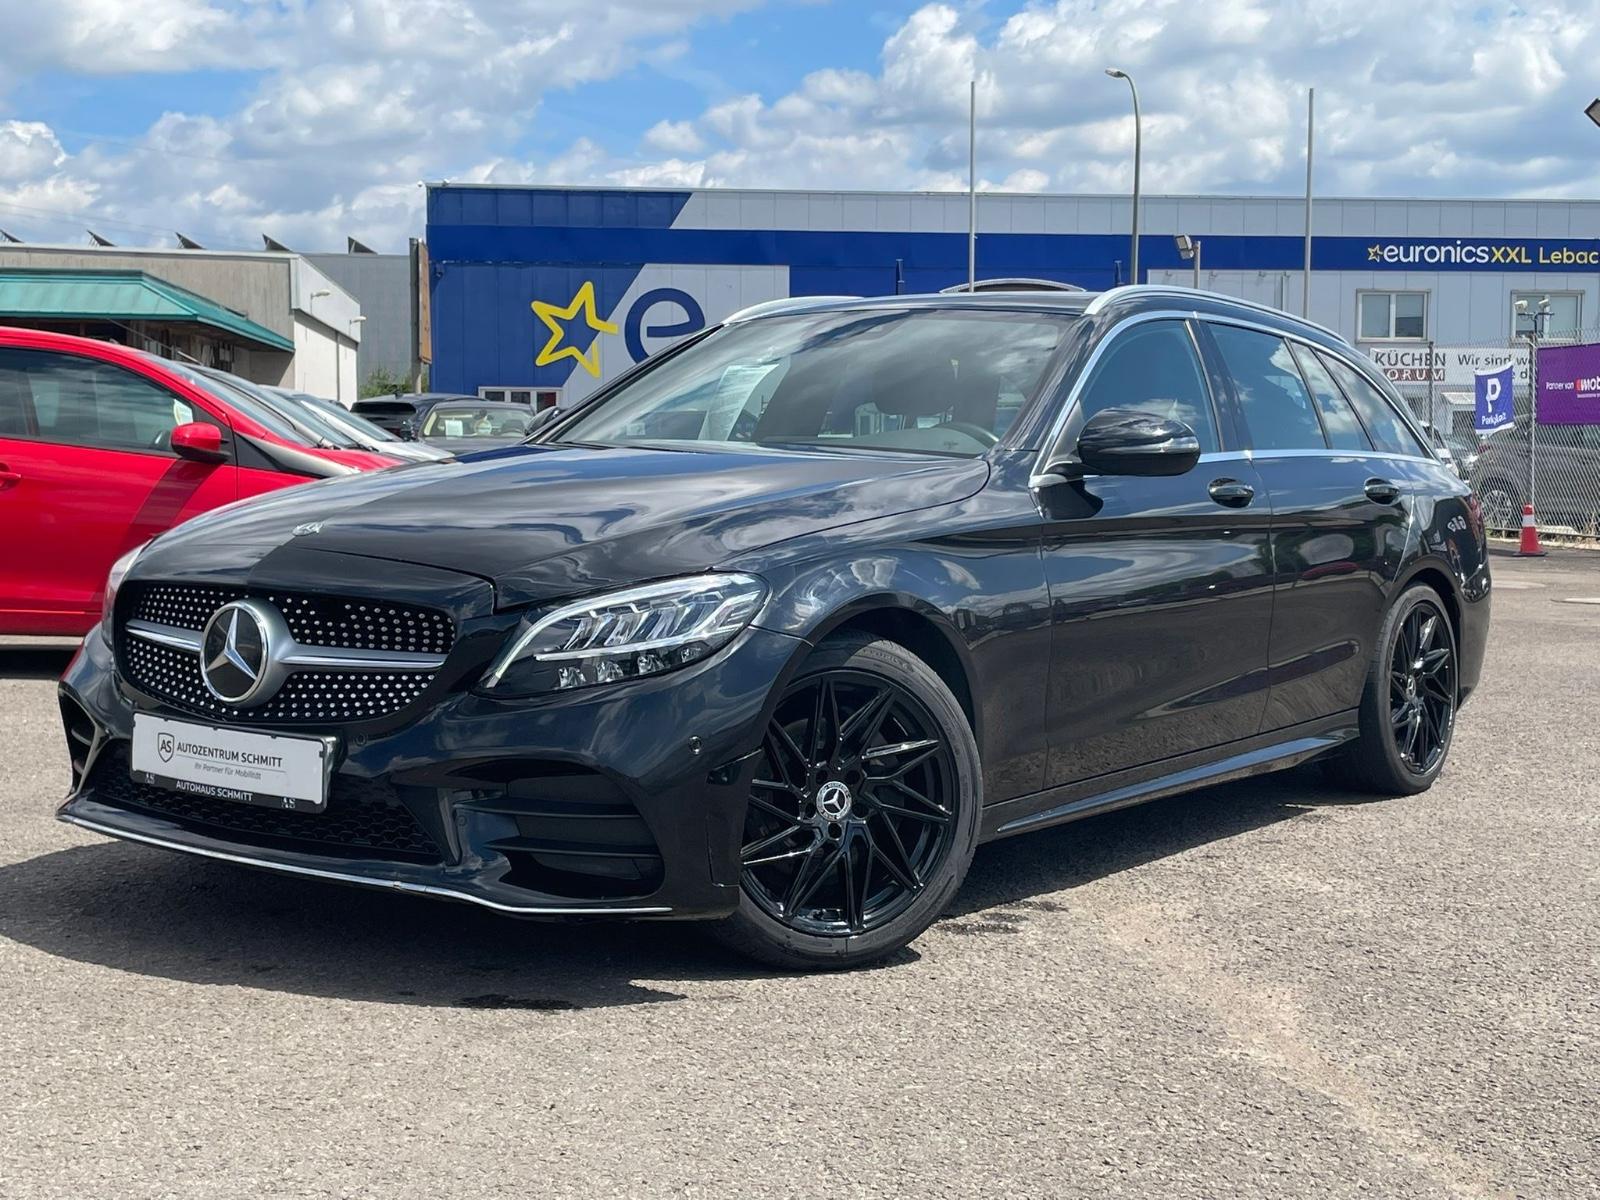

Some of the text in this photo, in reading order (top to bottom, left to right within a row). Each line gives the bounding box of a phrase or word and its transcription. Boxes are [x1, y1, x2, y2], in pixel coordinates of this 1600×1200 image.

[1383, 240, 1489, 263] euronics
[1491, 247, 1532, 263] XXL
[1375, 350, 1446, 366] KÜCHEN
[1457, 354, 1480, 366] Wir
[1386, 369, 1444, 380] ORUM
[1486, 377, 1501, 413] P
[160, 739, 172, 753] AS
[177, 742, 283, 767] AUTOZENTRUM SCHMITT
[203, 763, 224, 774] Partner
[225, 766, 235, 775] für
[176, 780, 253, 802] AUTOHAUS SCHMITT
